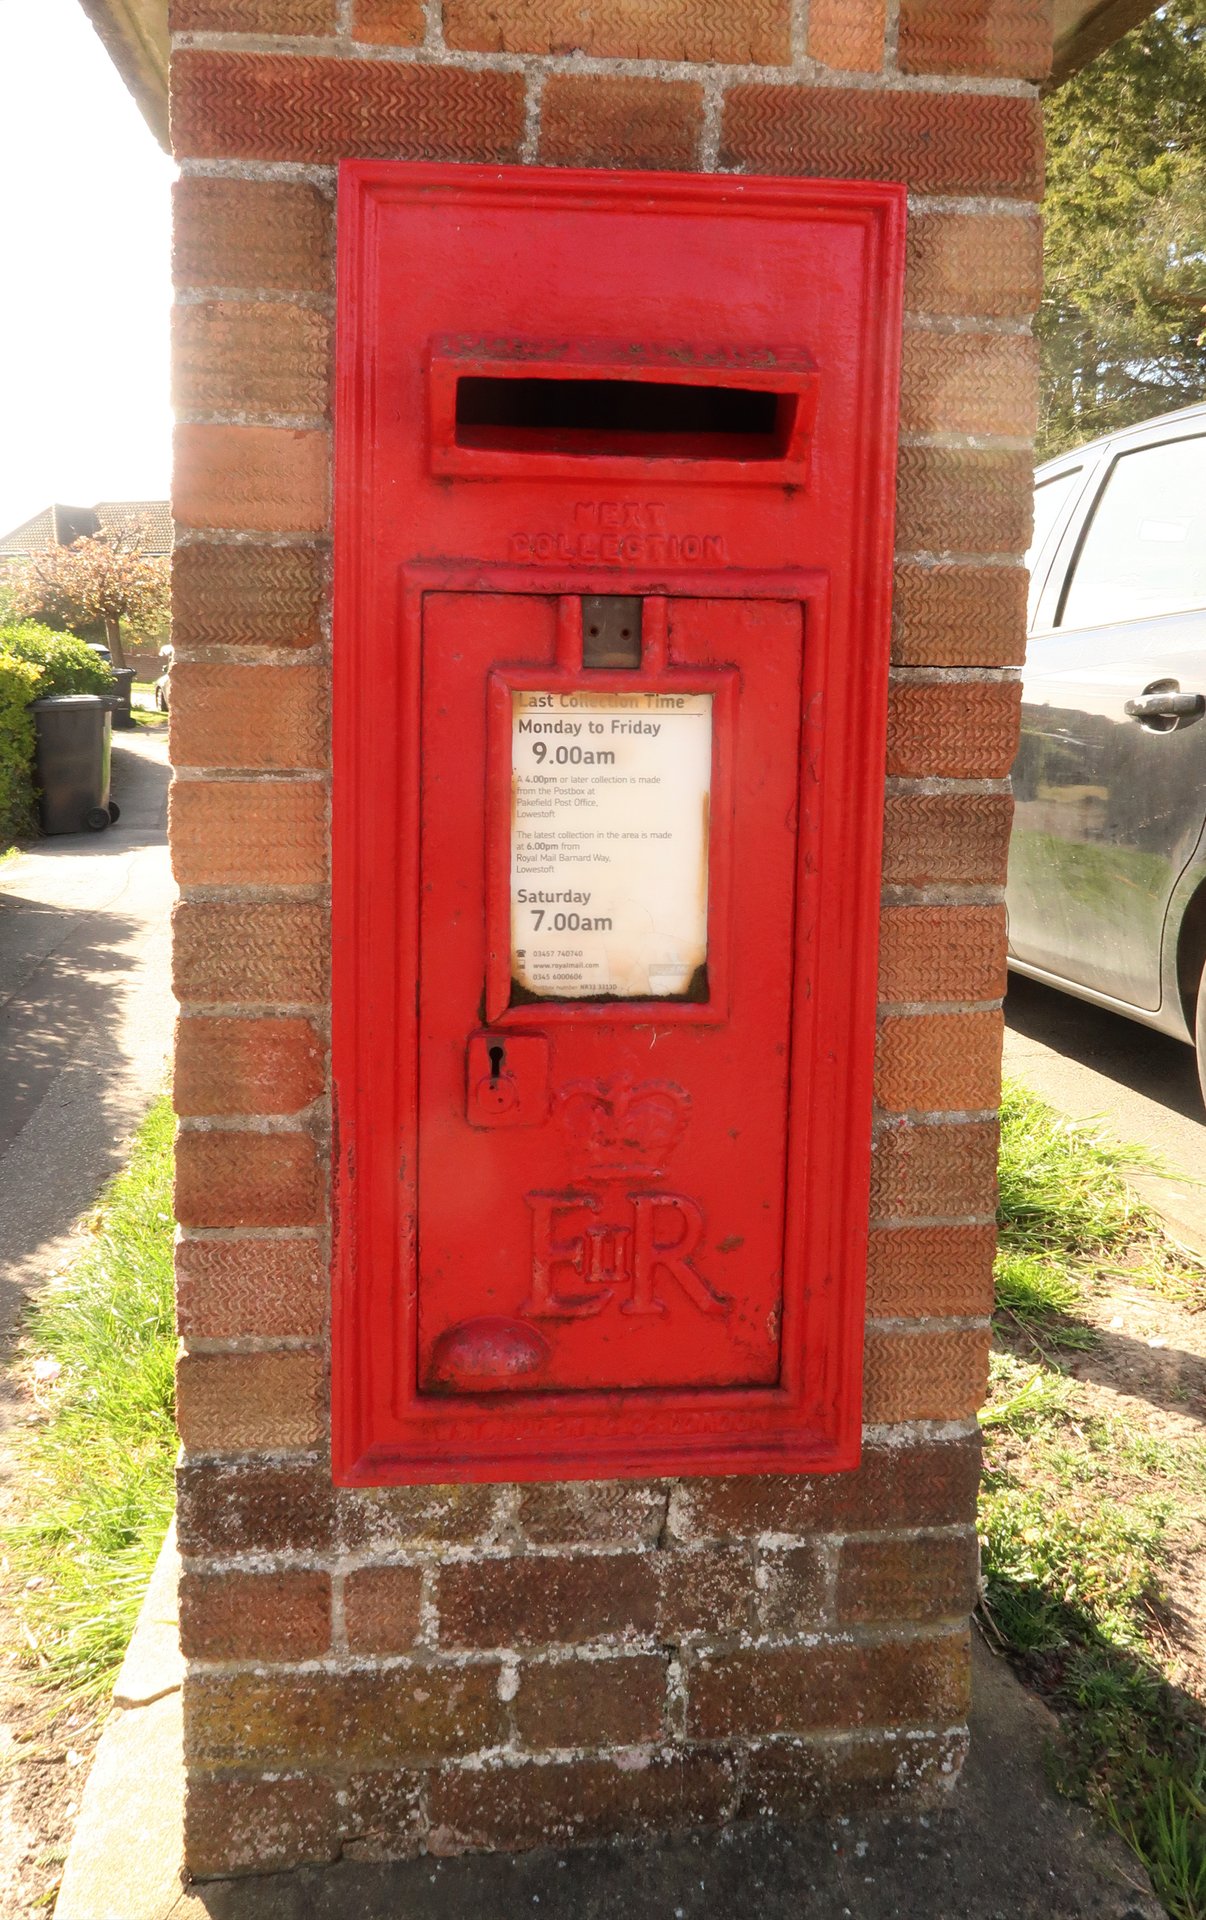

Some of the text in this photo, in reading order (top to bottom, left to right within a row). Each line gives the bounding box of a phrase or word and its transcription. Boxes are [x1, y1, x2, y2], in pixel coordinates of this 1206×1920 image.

[508, 532, 730, 561] COLLECTION
[518, 693, 554, 708] Last
[644, 693, 685, 709] Time
[518, 719, 661, 737] Monday to Friday
[532, 741, 615, 765] 9.00am
[525, 775, 557, 785] 4.00pm
[559, 776, 568, 784] or
[570, 775, 588, 784] later
[591, 775, 628, 784] collection
[630, 776, 636, 784] is
[639, 776, 661, 784] made
[517, 787, 536, 795] from
[538, 787, 551, 795] the
[554, 787, 584, 795] Postbox
[517, 798, 552, 807] Pakefield
[554, 798, 572, 807] Post
[516, 809, 556, 818] Lowestoft
[517, 831, 672, 840] The latest collection in the area is made
[526, 842, 559, 852] 6.00pm
[561, 842, 580, 850] from
[516, 853, 538, 863] Royal
[540, 853, 557, 862] Mail
[516, 865, 555, 873] Lowestoft
[517, 889, 591, 906] Saturday
[530, 909, 613, 932] 7.00am
[533, 962, 600, 970] www.royalmail.com
